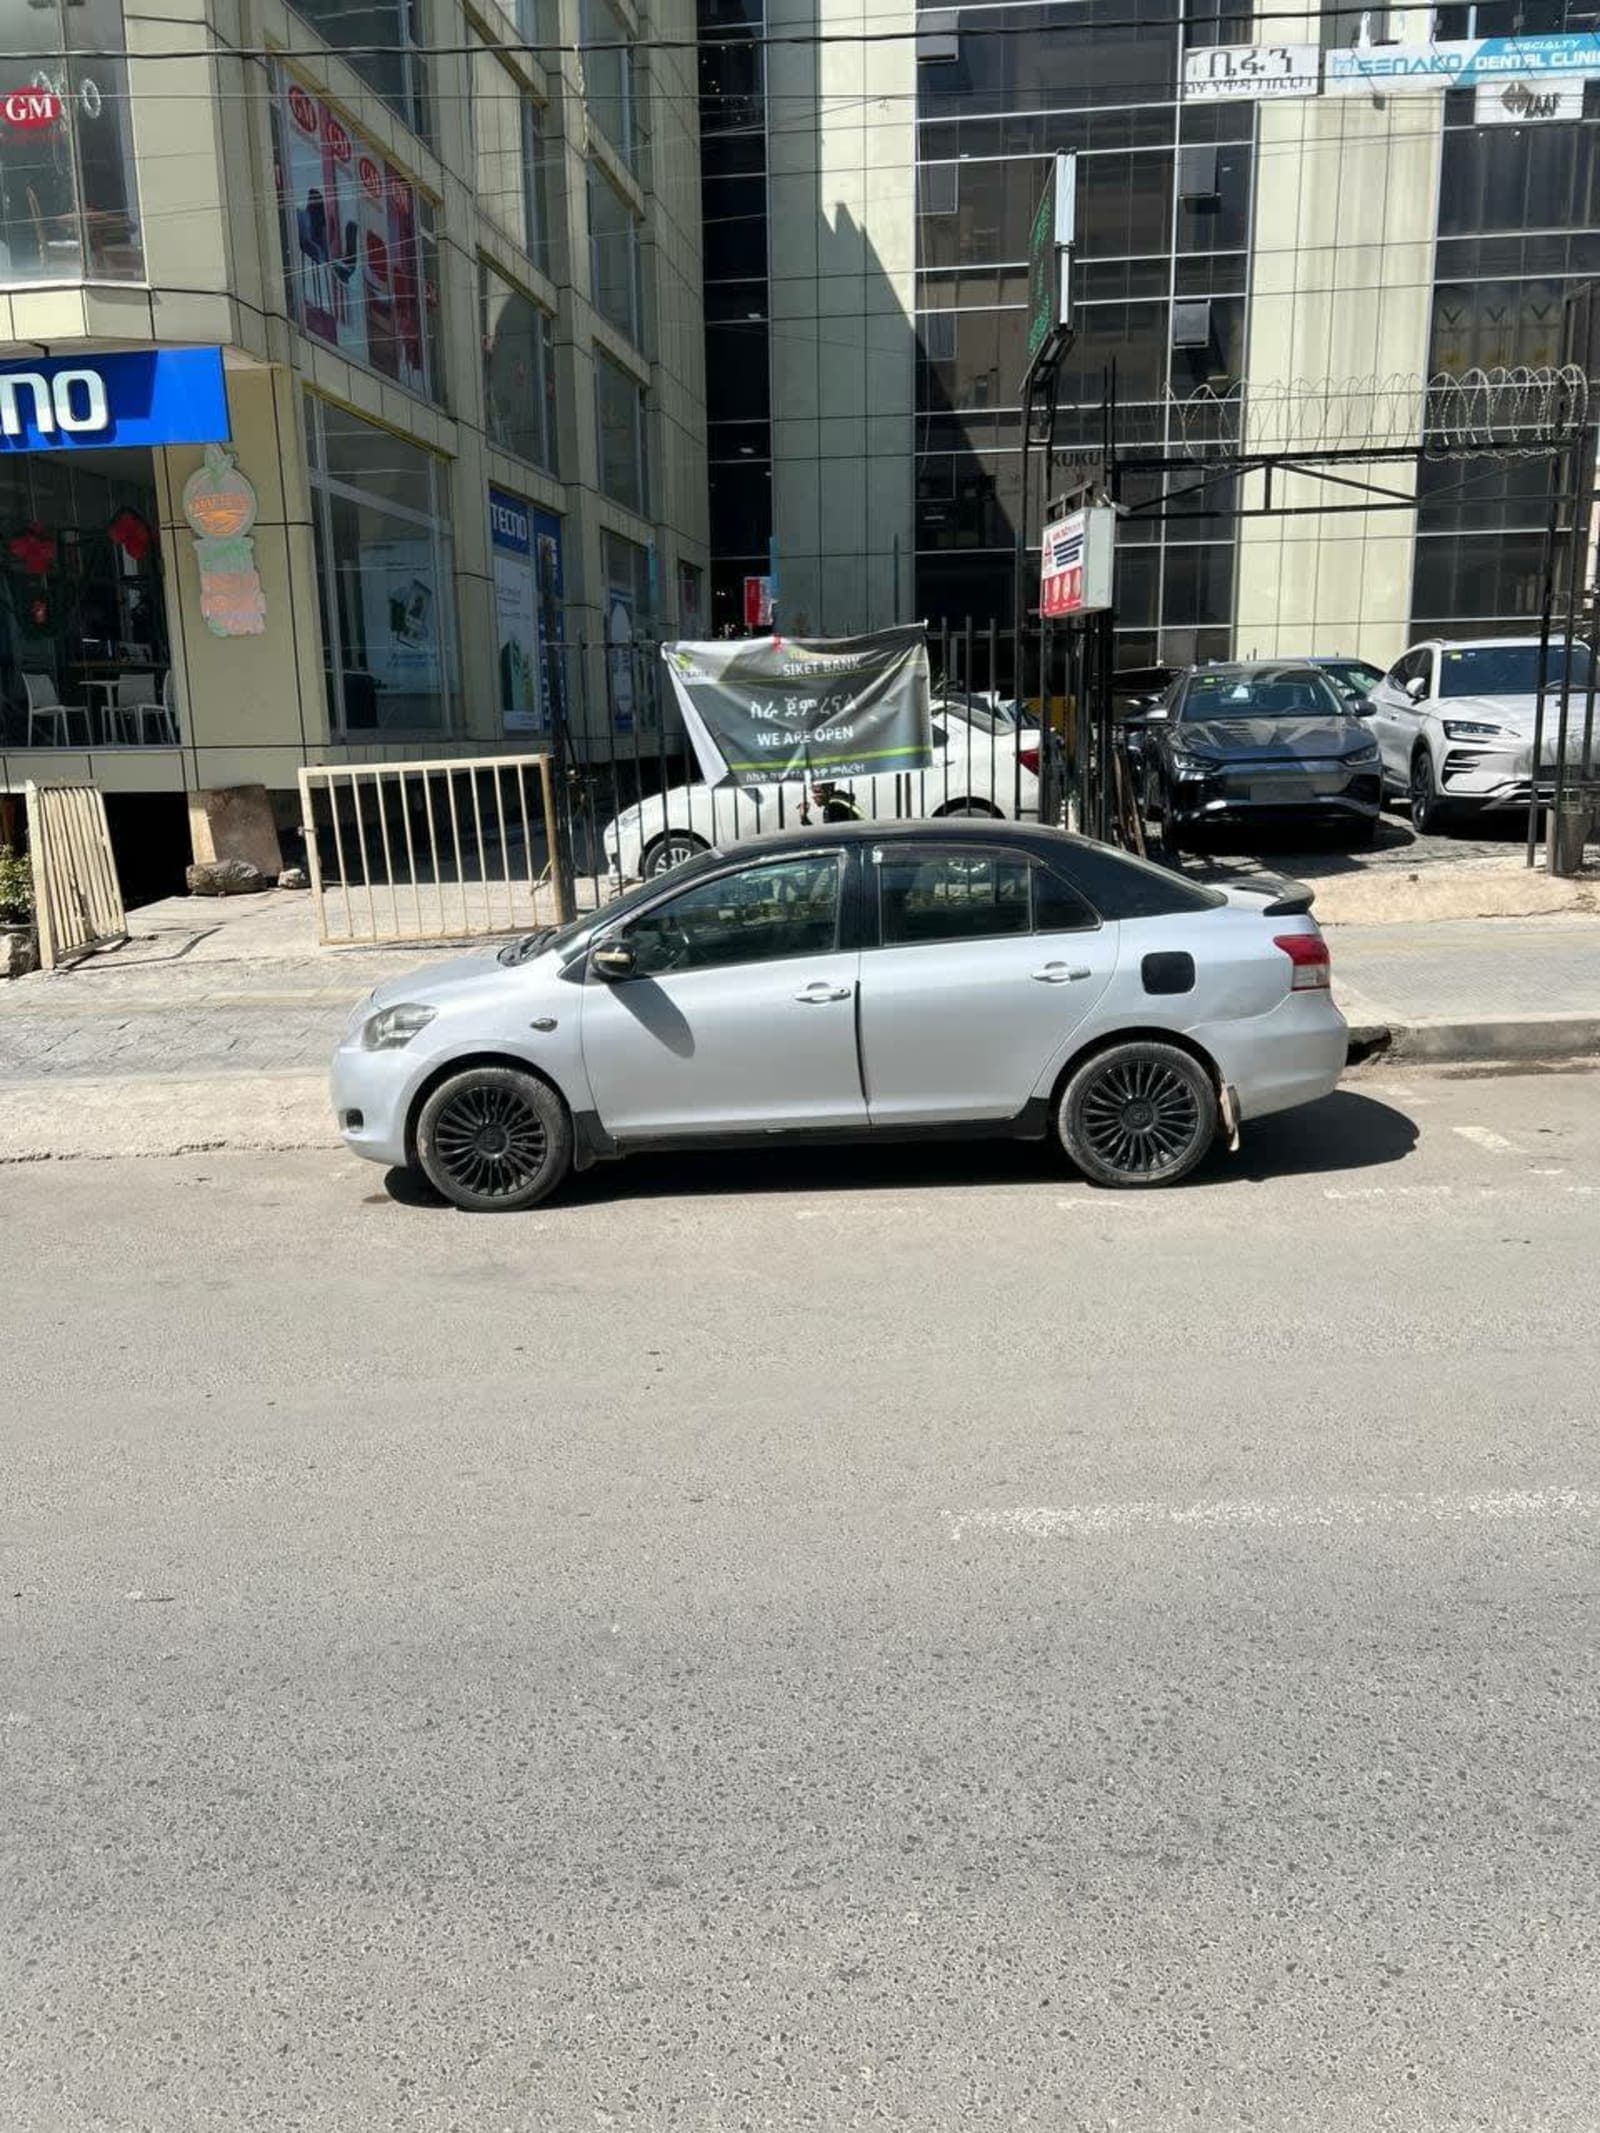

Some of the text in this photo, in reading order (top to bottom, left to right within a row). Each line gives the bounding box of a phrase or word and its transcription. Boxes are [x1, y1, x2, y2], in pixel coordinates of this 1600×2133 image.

[1475, 53, 1548, 69] DENTAL
[5, 94, 54, 121] GM
[757, 726, 854, 746] WE ARE OPEN
